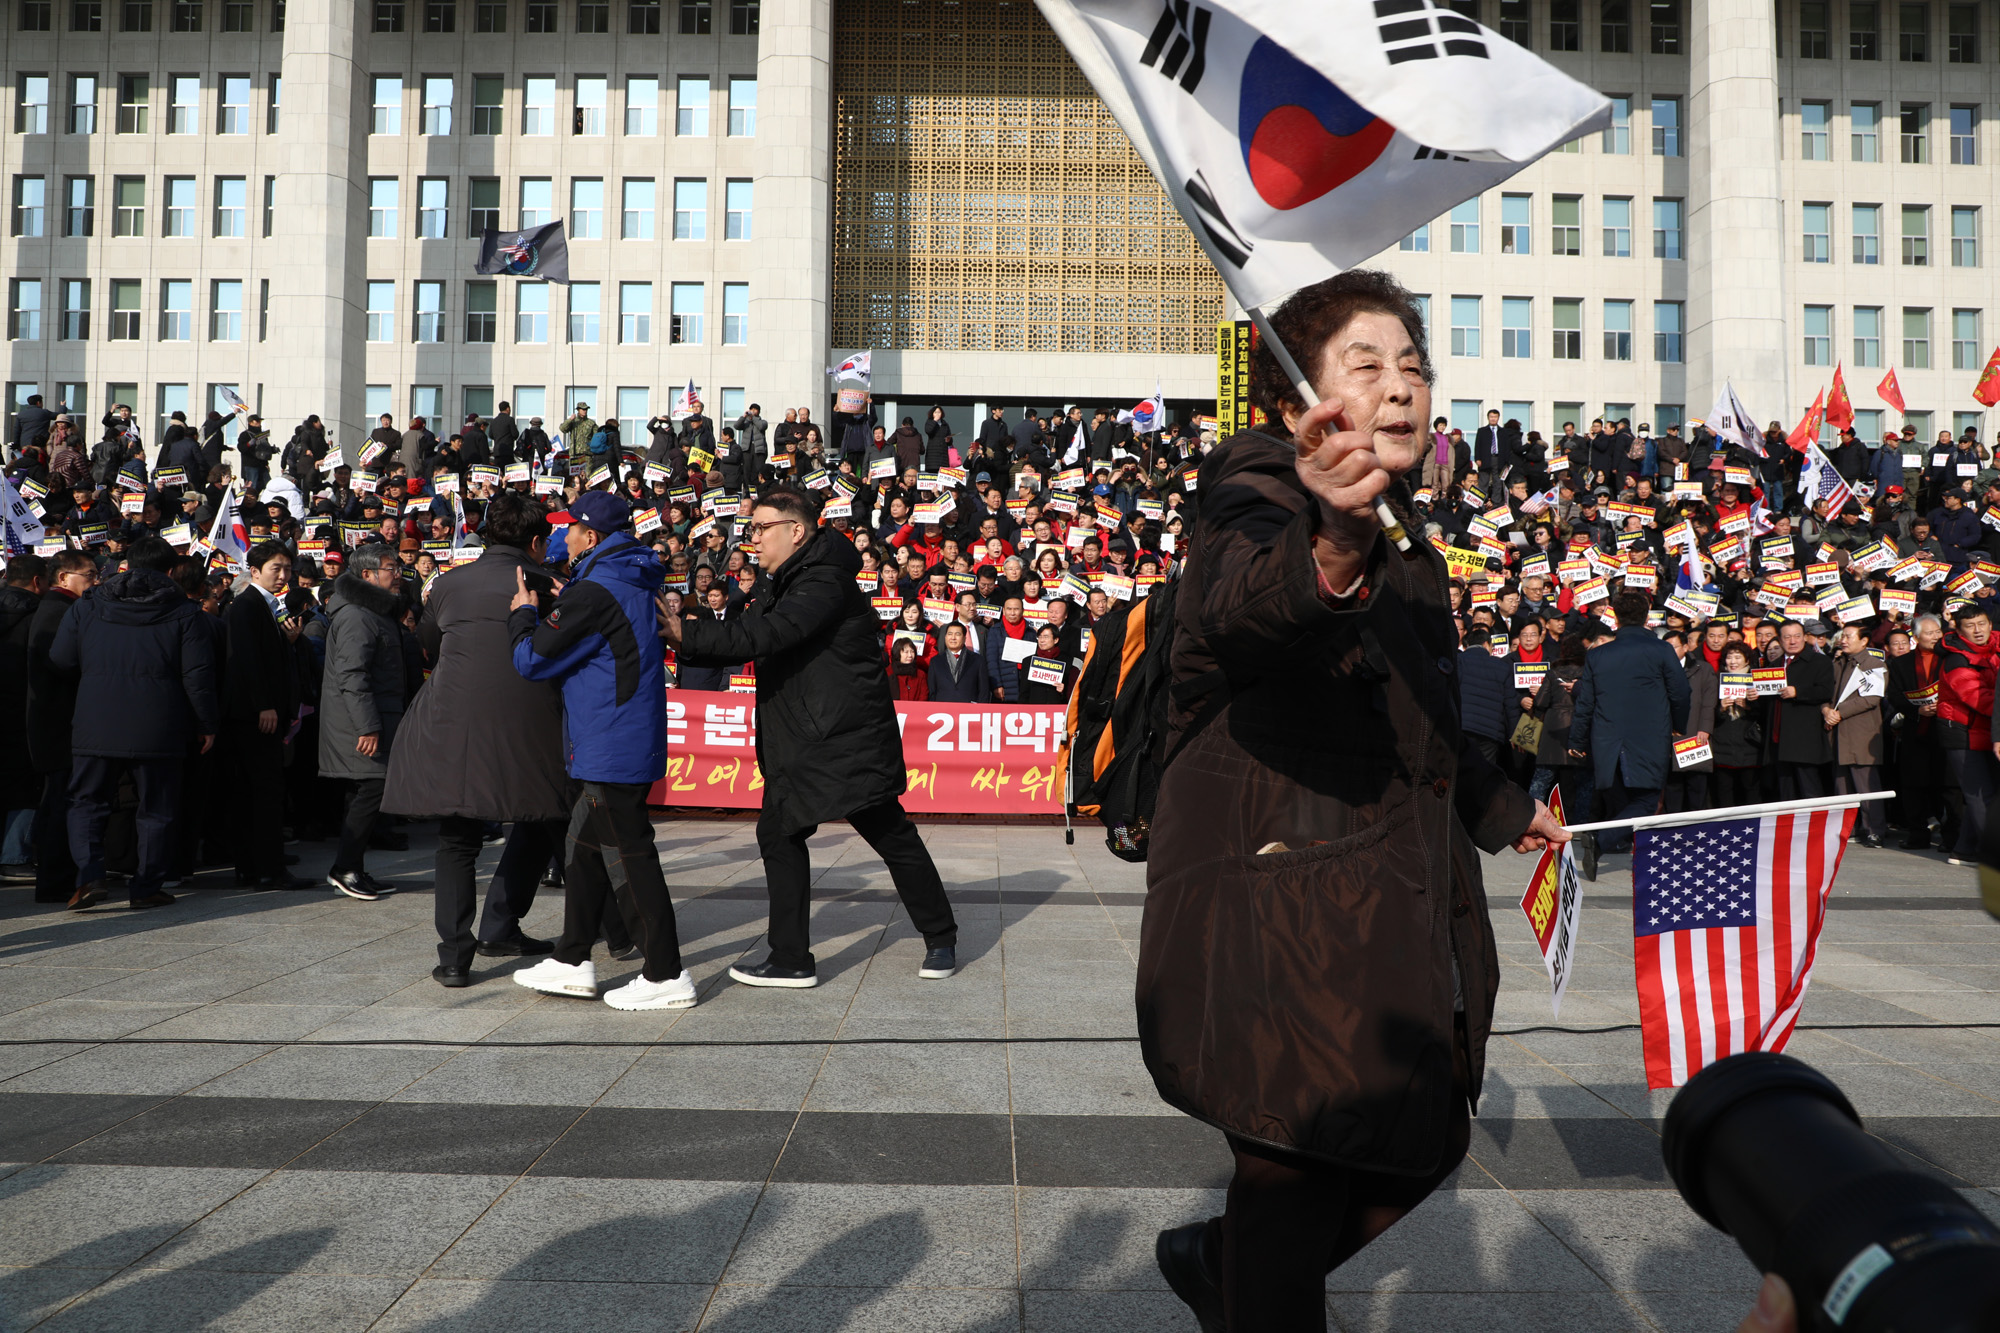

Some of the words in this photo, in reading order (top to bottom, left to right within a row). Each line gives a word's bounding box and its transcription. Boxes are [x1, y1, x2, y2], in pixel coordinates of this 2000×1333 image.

[1220, 375, 1231, 396] 없는
[1097, 515, 1107, 523] 거법
[1446, 551, 1485, 567] 공수처법
[1031, 669, 1059, 682] 결사반대!
[704, 704, 756, 746] 분
[1530, 854, 1558, 939] 좌파독
[1552, 926, 1568, 995] 선거법
[1561, 856, 1577, 926] 반대!
